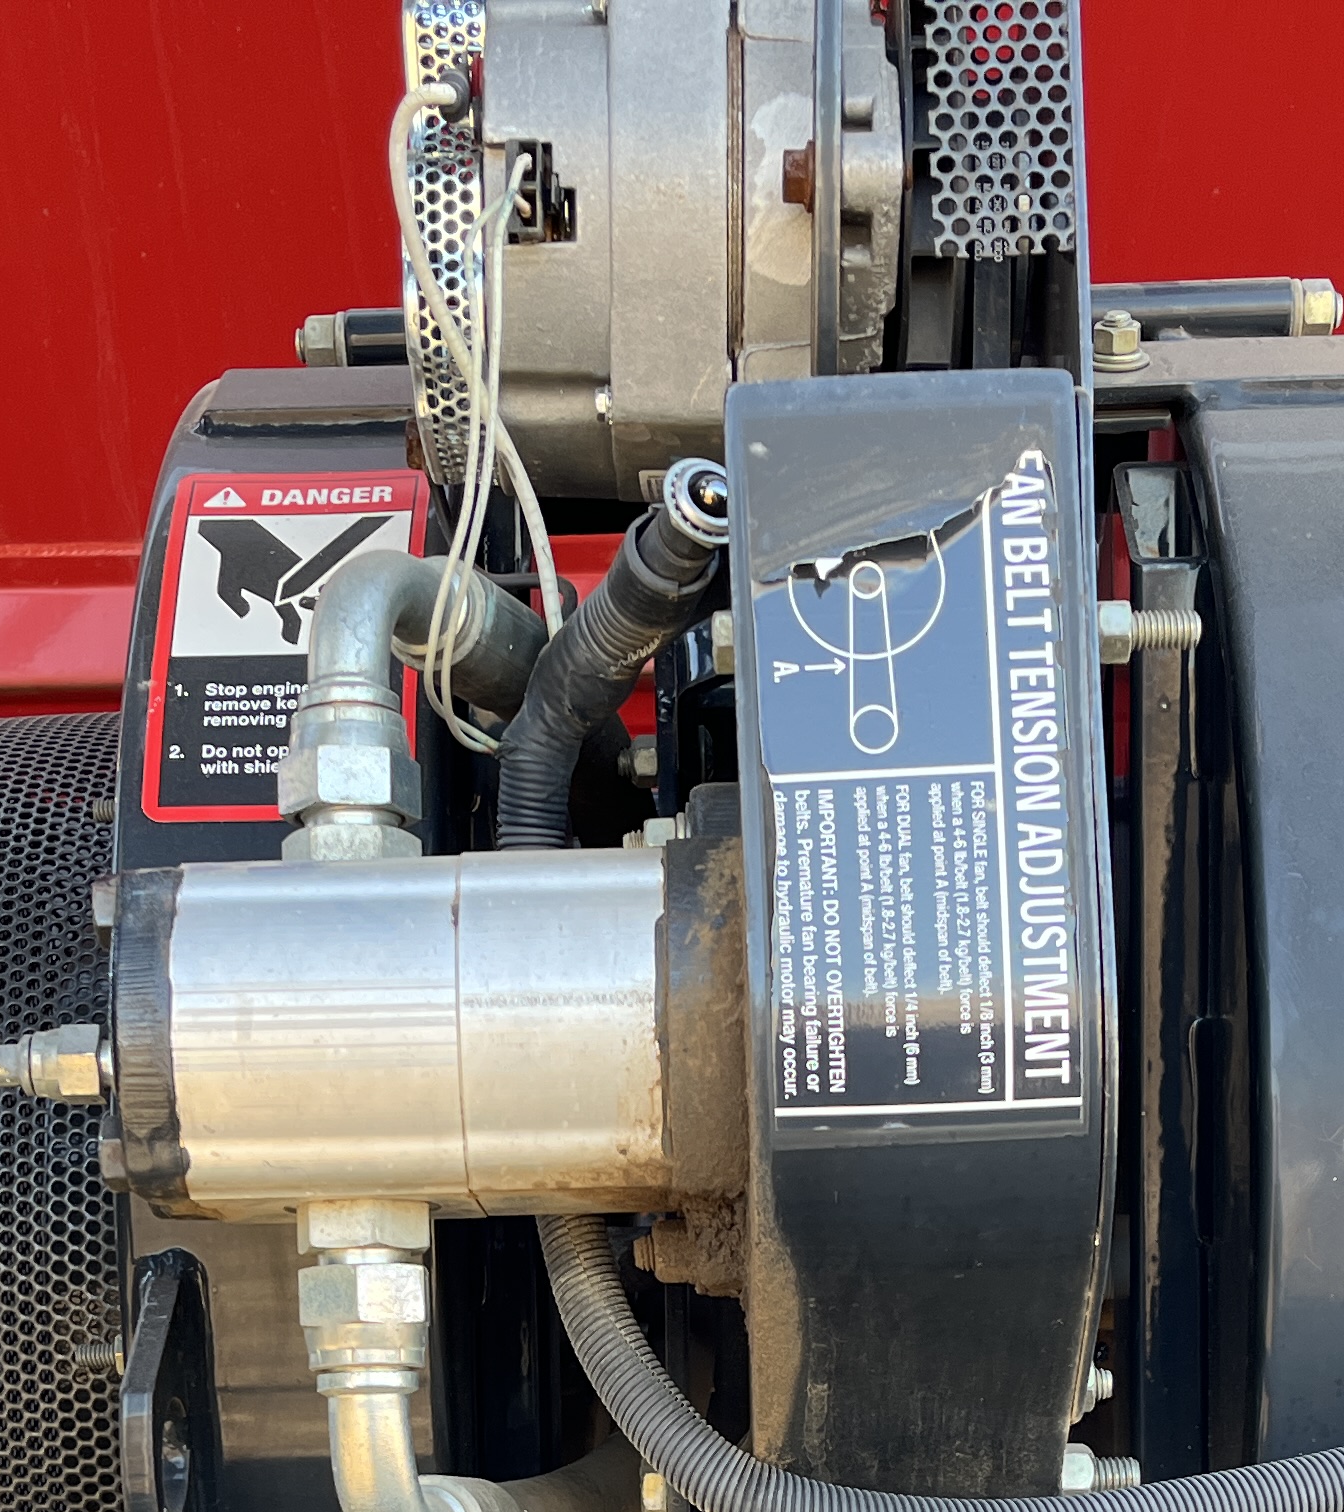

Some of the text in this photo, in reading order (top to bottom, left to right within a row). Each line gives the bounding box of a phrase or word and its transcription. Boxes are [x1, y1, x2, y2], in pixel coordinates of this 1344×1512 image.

[260, 486, 393, 506] DANGER
[1003, 537, 1052, 633] BELT
[773, 661, 800, 683] A.
[174, 683, 189, 697] 1.
[205, 682, 247, 698] Stop
[204, 696, 298, 712] remove ke
[203, 712, 287, 728] removing
[1008, 641, 1061, 812] TENSION
[168, 744, 185, 759] 2.
[201, 744, 227, 759] Do
[232, 743, 263, 758] not
[200, 760, 239, 775] with
[876, 785, 890, 818] when
[951, 782, 965, 815] when
[877, 821, 888, 830] a
[952, 817, 963, 826] a
[878, 832, 892, 852] 4-6
[953, 828, 966, 848] 4-6
[777, 860, 791, 876] to
[853, 786, 879, 998] applied at point A (midspan of belt).
[928, 783, 953, 995] applied at point A (midspan of belt).
[775, 880, 795, 953] hydraulic
[795, 790, 823, 1092] belts. Premature fan bearing failure or
[817, 789, 846, 1092] IMPORTANT: DO NOT OVERTIGHTEN
[896, 784, 920, 1085] FOR DUAL fan, belt should deflect 1/4 inch (6 mm)
[971, 781, 995, 1093] FOR SINGLE fan, belt should deflect 1/8 inch (3 mm)
[1016, 822, 1070, 1084] ADJUSTMENT
[780, 958, 797, 1006] motor
[884, 992, 899, 1023] force
[959, 988, 974, 1020] force
[779, 1010, 796, 1044] may
[885, 1026, 899, 1037] is
[960, 1023, 975, 1034] is
[783, 1048, 797, 1100] occur.
